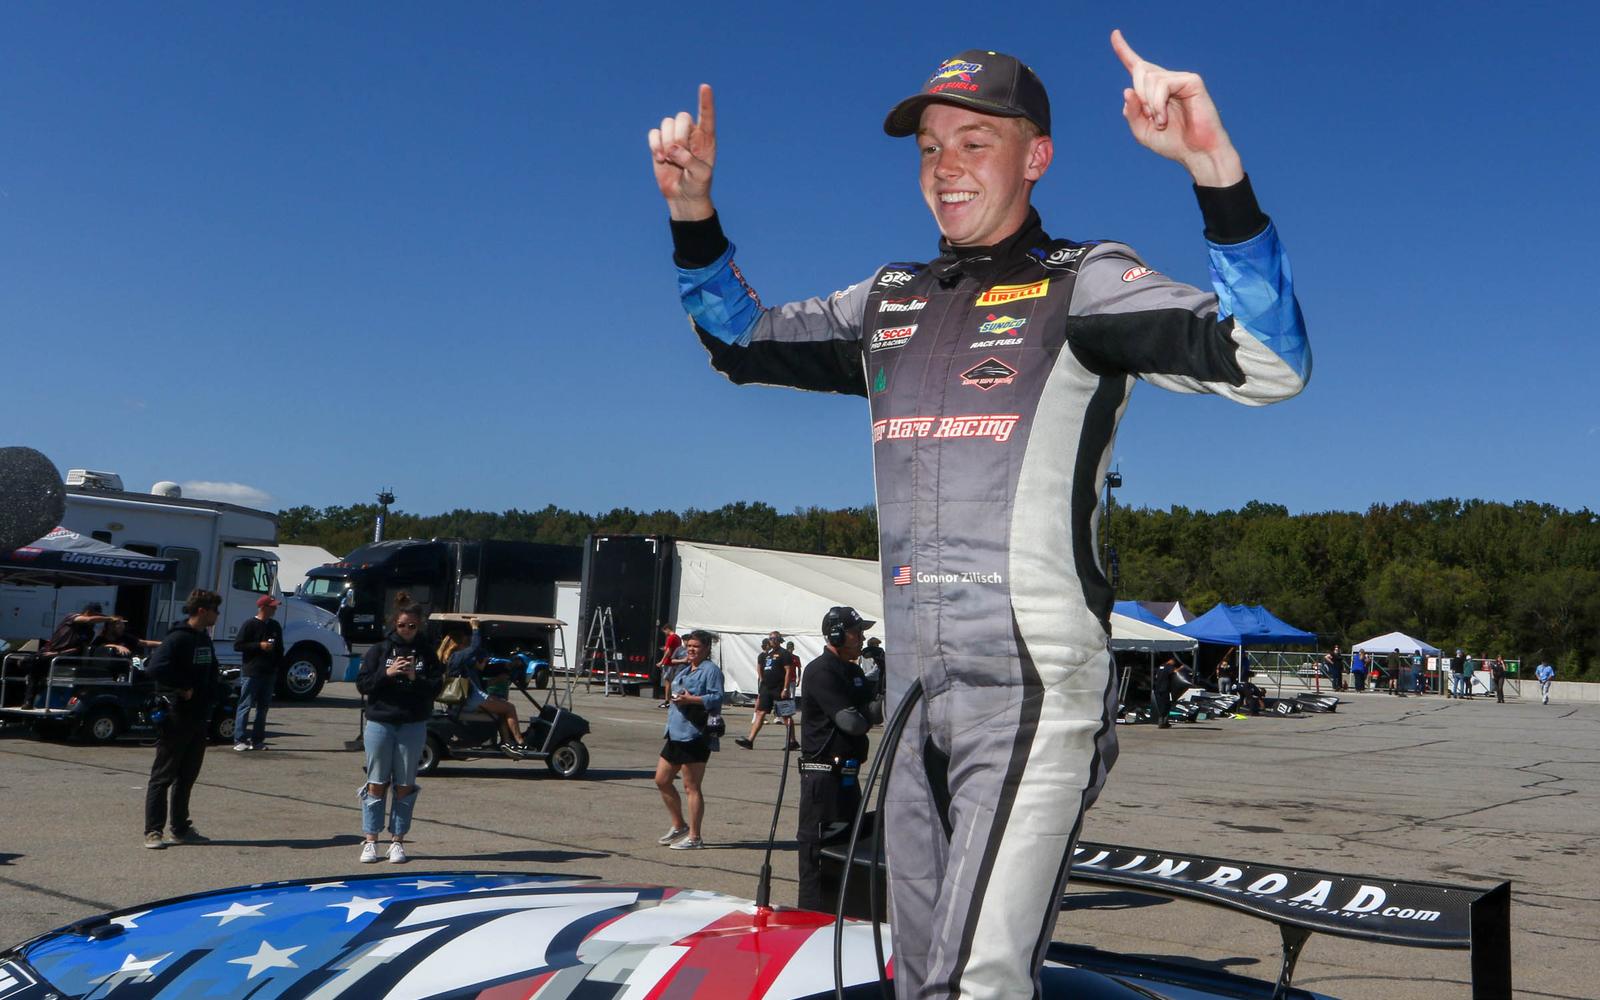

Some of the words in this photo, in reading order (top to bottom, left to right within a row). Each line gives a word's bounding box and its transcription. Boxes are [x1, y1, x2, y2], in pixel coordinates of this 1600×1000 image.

[983, 283, 1043, 302] PIRELLI
[982, 319, 1022, 331] SUNOCO
[883, 327, 912, 339] SCCA
[970, 340, 996, 349] RACE
[995, 337, 1023, 346] FUELS
[887, 417, 936, 439] Hare
[933, 414, 1019, 442] Racing
[916, 572, 959, 583] Connor
[961, 571, 1002, 584] Zilisch
[1275, 898, 1369, 919] COMPANY
